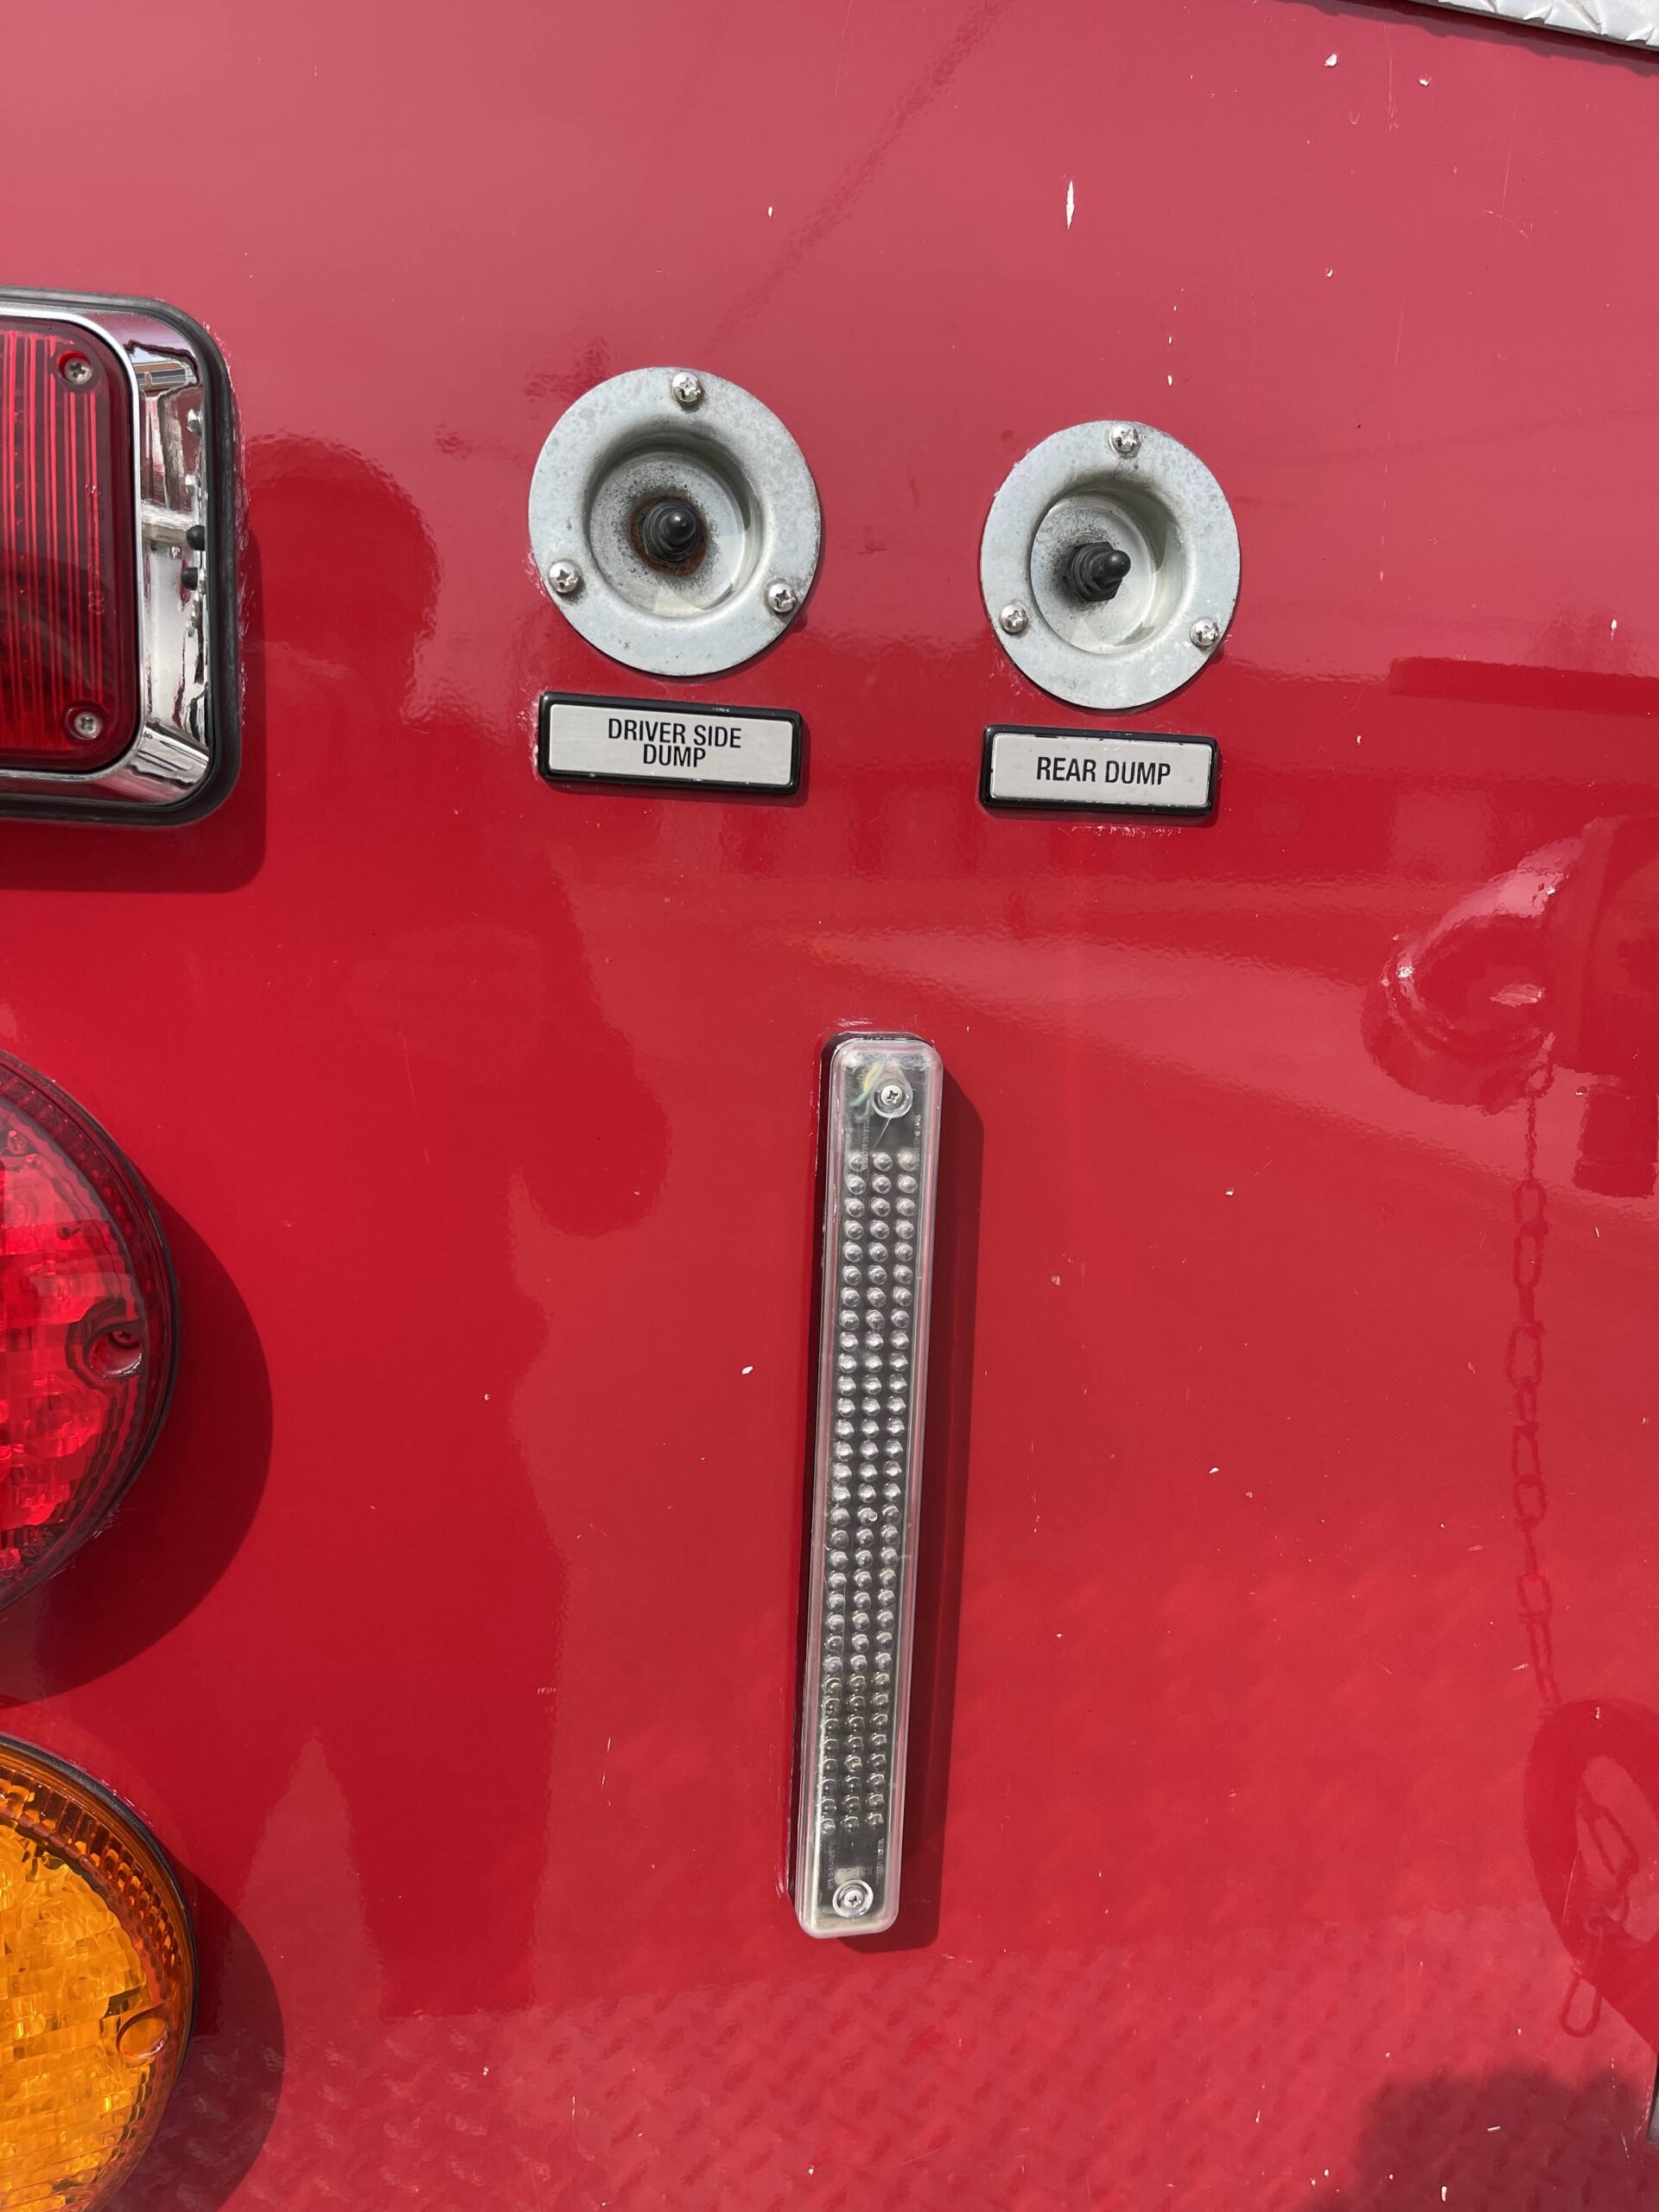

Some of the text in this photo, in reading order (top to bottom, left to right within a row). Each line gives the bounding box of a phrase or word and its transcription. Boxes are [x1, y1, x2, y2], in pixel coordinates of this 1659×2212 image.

[608, 718, 742, 748] DRIVER SIDE
[643, 743, 707, 768] DUMP
[1036, 756, 1171, 785] REAR DUMP
